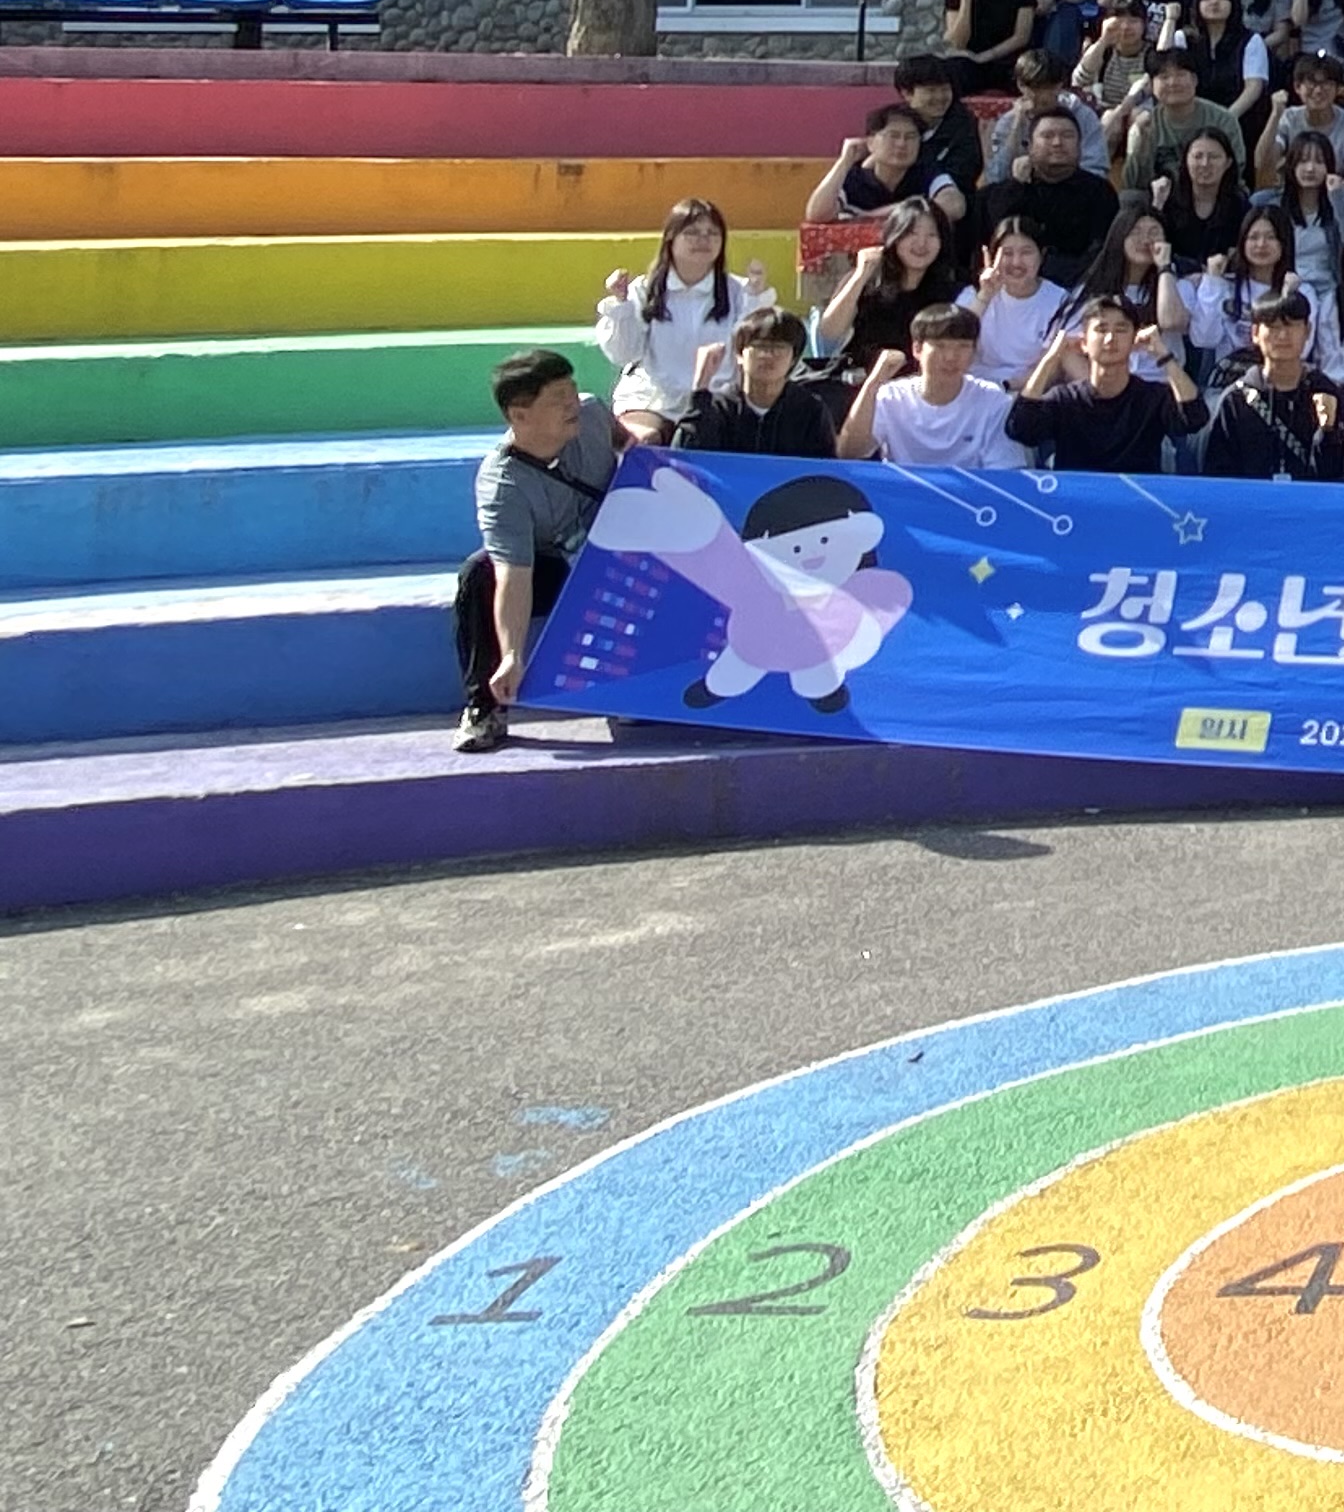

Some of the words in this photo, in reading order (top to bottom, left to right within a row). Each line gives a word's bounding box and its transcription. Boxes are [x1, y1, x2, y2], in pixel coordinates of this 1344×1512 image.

[427, 1255, 563, 1326] 1
[686, 1242, 851, 1316] 2
[966, 1243, 1101, 1320] 3
